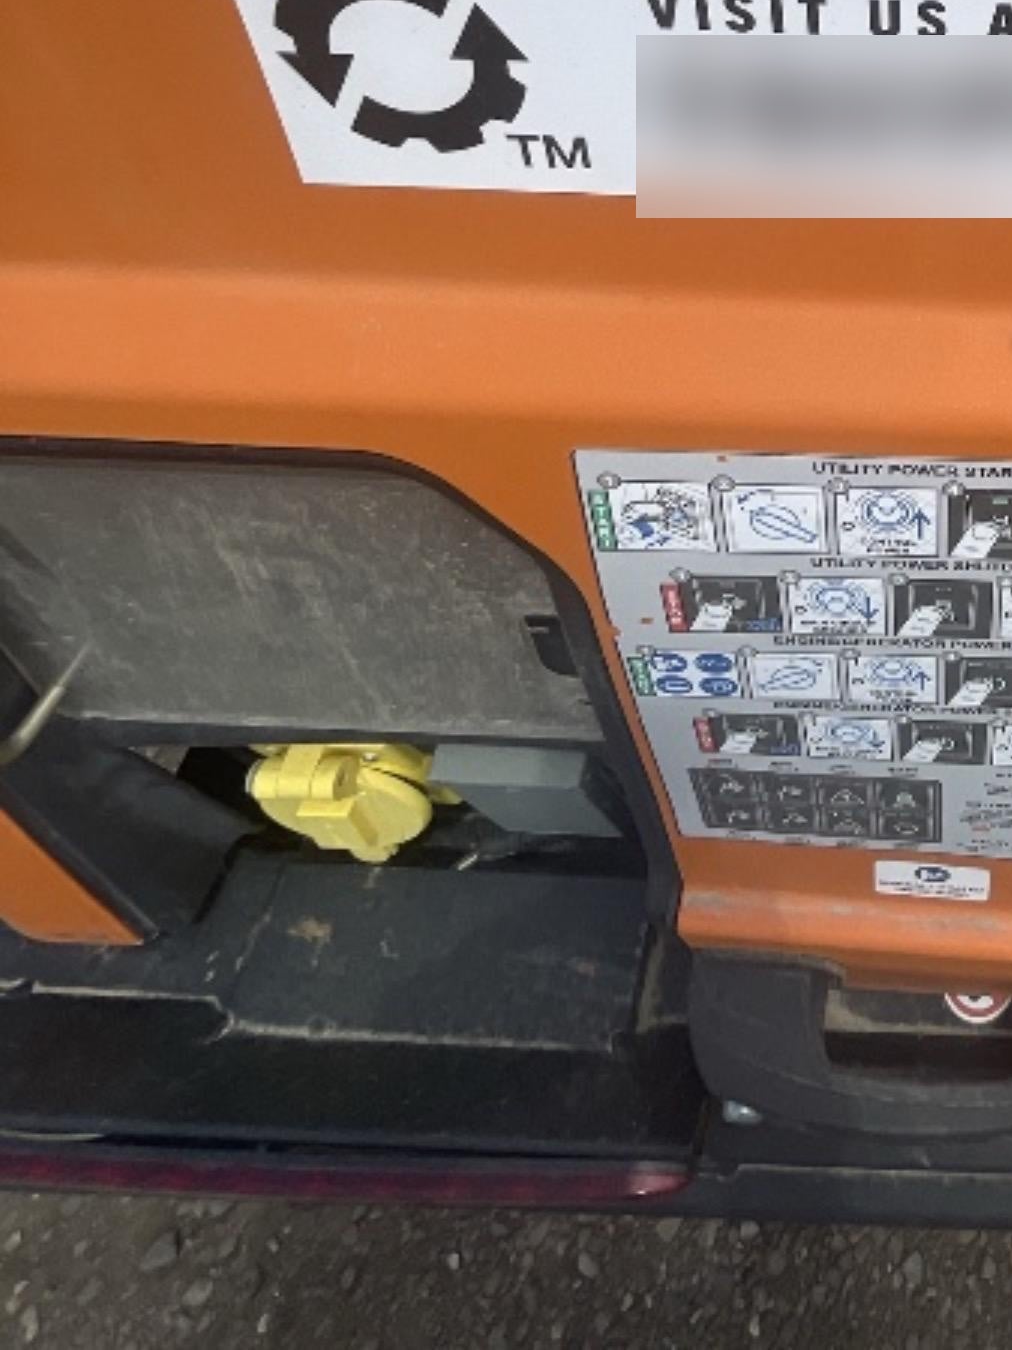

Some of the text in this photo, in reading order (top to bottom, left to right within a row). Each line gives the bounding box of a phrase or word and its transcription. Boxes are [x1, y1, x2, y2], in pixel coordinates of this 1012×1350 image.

[506, 134, 592, 169] TM
[812, 461, 883, 475] UTILITY
[888, 464, 958, 477] POWER
[810, 557, 877, 568] UTILITY
